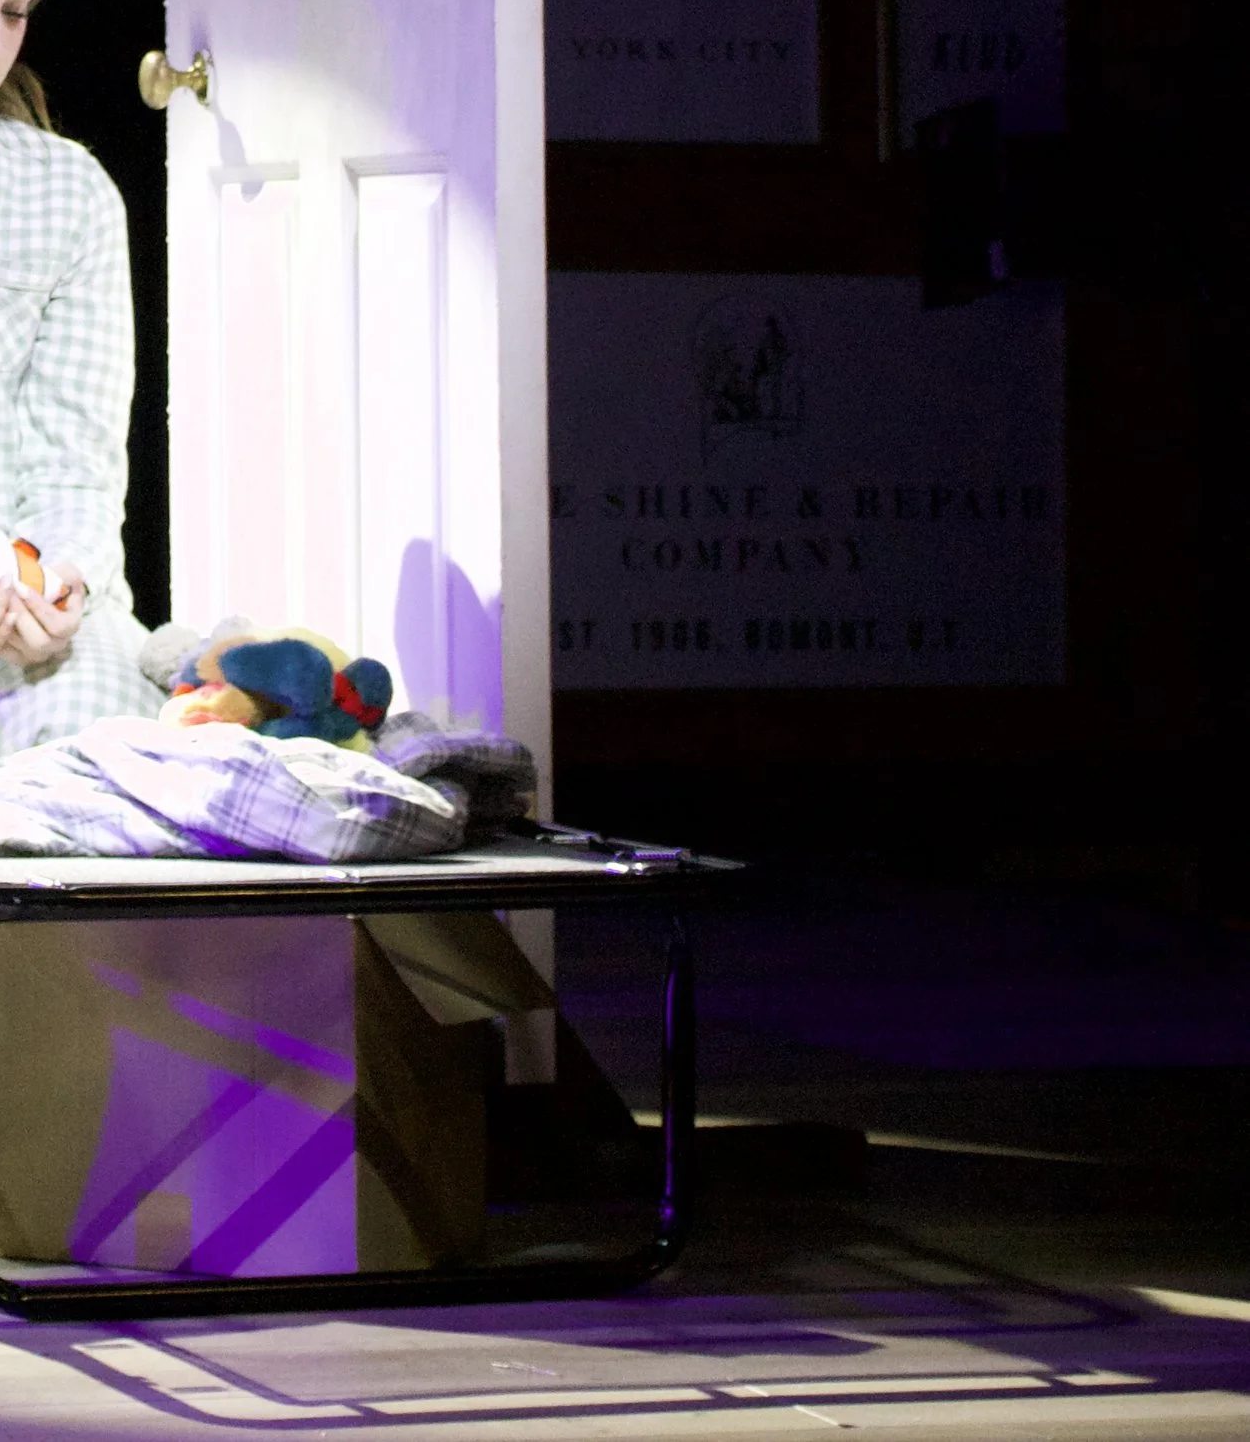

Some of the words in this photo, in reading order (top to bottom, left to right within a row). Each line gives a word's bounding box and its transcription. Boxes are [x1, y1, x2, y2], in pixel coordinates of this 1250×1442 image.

[570, 38, 676, 62] YORK
[698, 38, 794, 62] CITY
[603, 484, 768, 518] SHINE
[797, 484, 821, 518] &
[856, 486, 1048, 520] REPAIR
[621, 538, 860, 572] COMPANY
